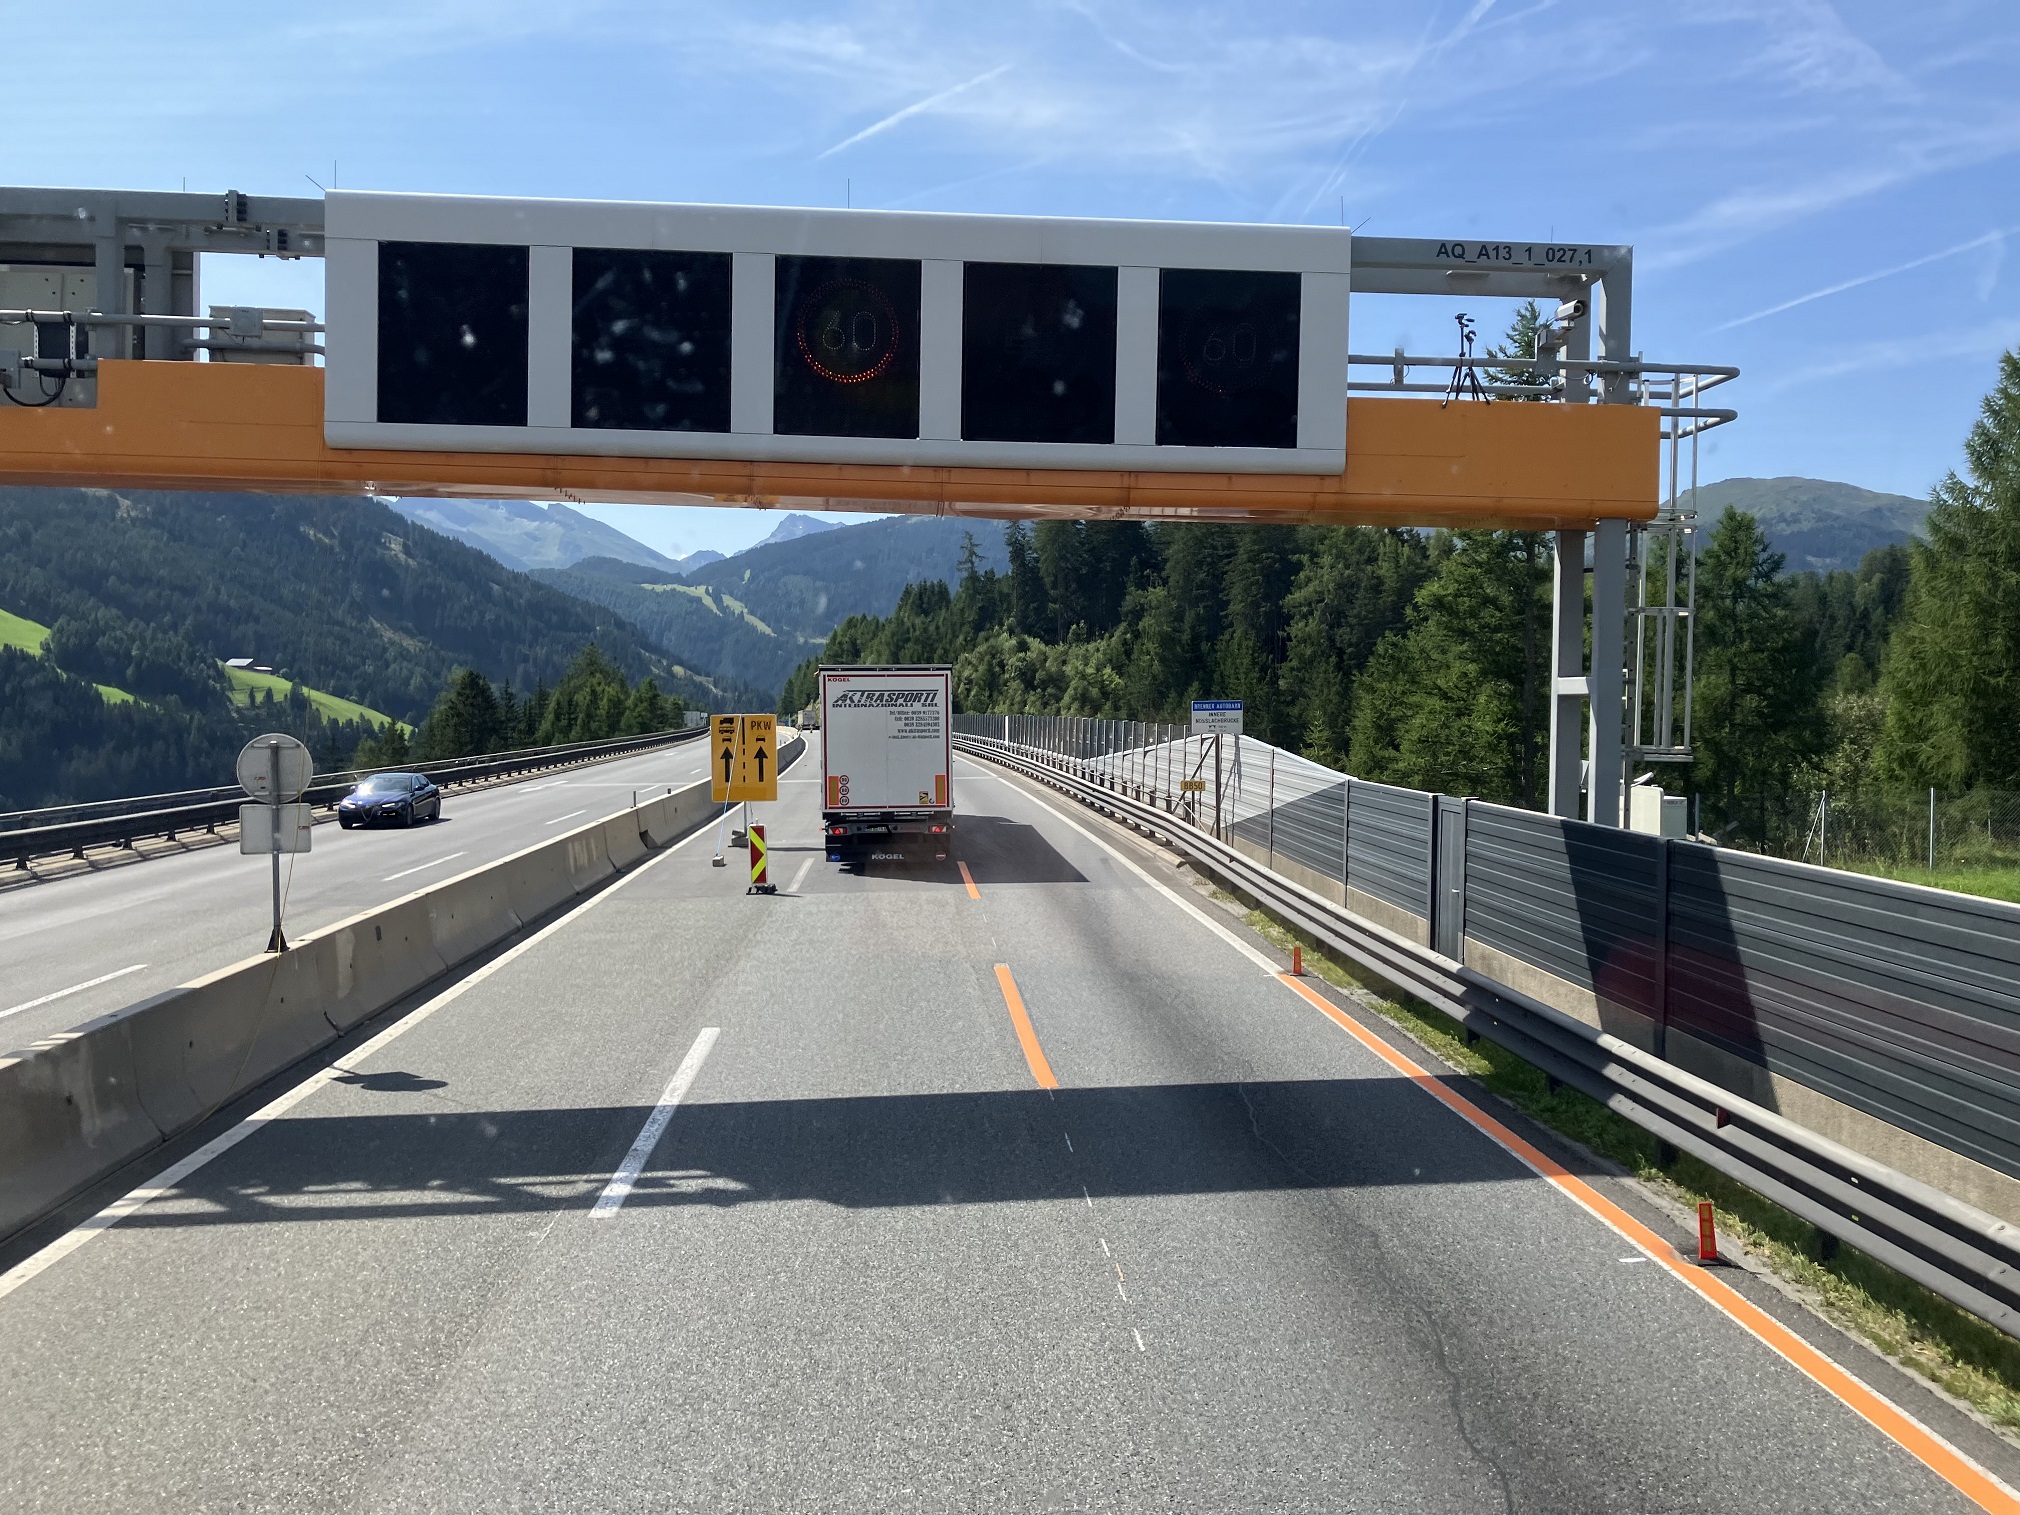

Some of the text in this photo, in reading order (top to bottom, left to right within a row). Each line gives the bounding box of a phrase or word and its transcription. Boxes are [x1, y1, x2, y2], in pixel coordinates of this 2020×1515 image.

[1436, 243, 1592, 267] AQ_A13_1_027,1
[822, 310, 877, 351] 60
[1203, 322, 1257, 362] 60
[750, 720, 772, 731] PKW
